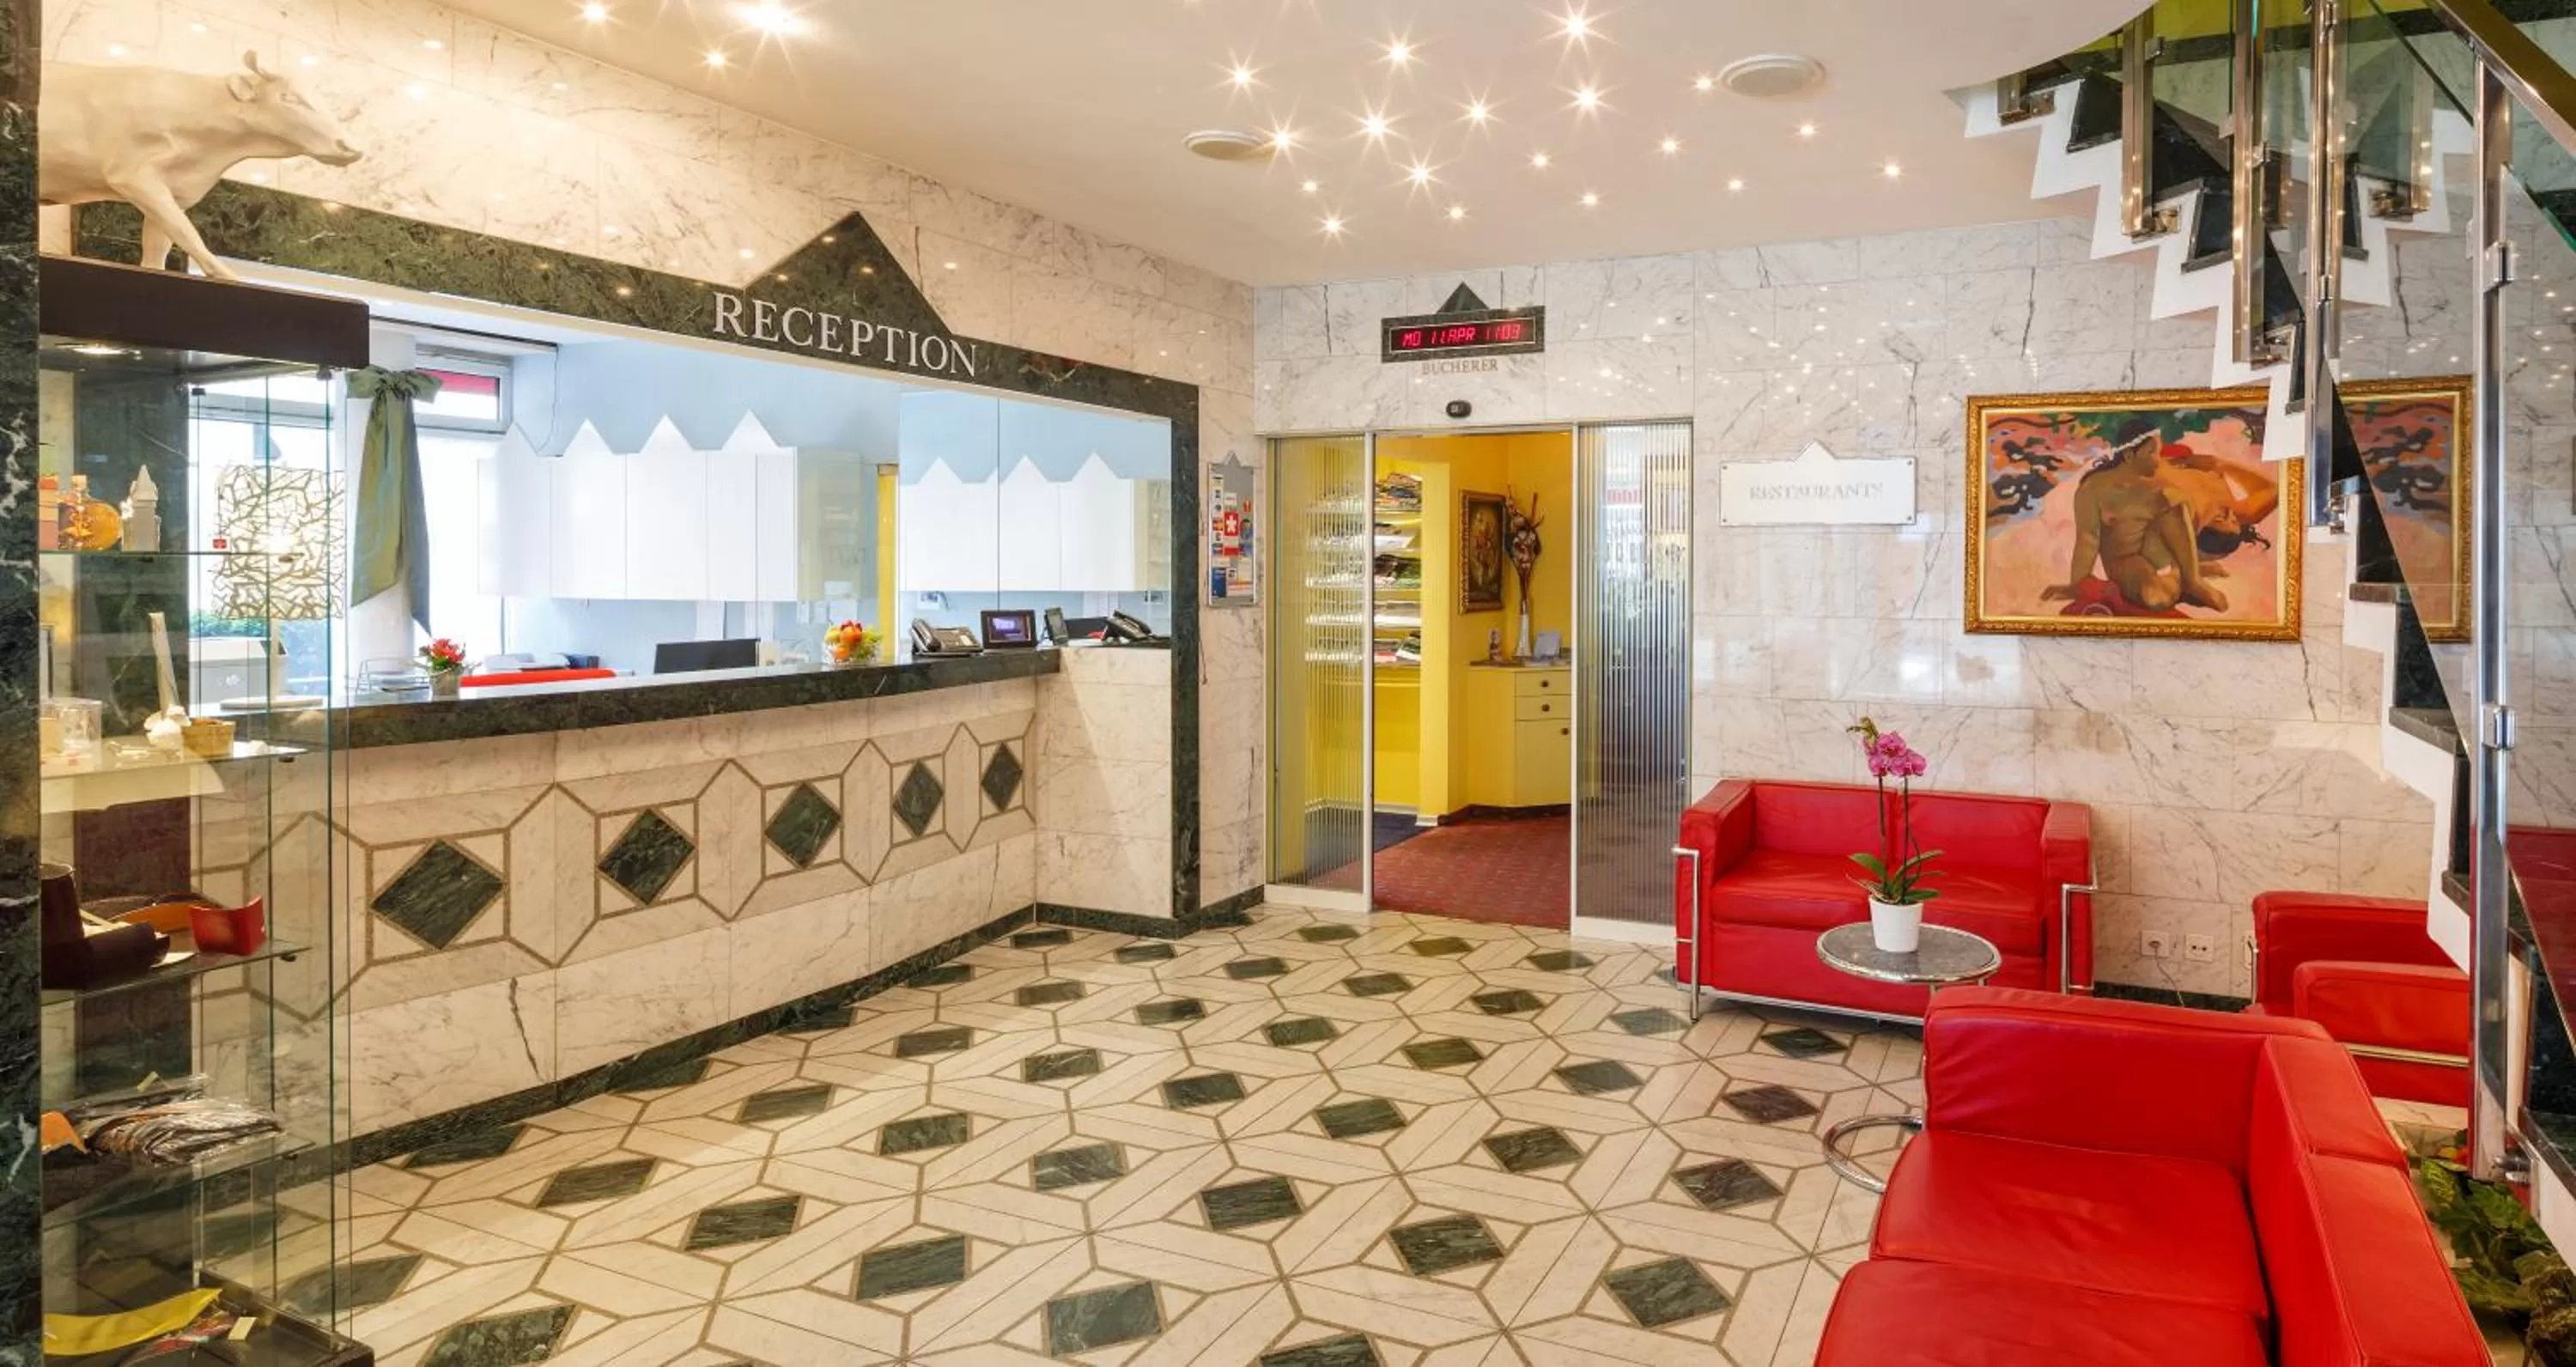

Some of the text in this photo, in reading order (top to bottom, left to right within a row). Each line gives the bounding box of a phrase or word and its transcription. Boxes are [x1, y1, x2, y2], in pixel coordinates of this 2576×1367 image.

[713, 292, 976, 377] RECEPTION
[1401, 331, 1422, 348] MO
[1422, 358, 1498, 375] BUCHERER
[1748, 482, 1883, 500] RESTAURANTS
